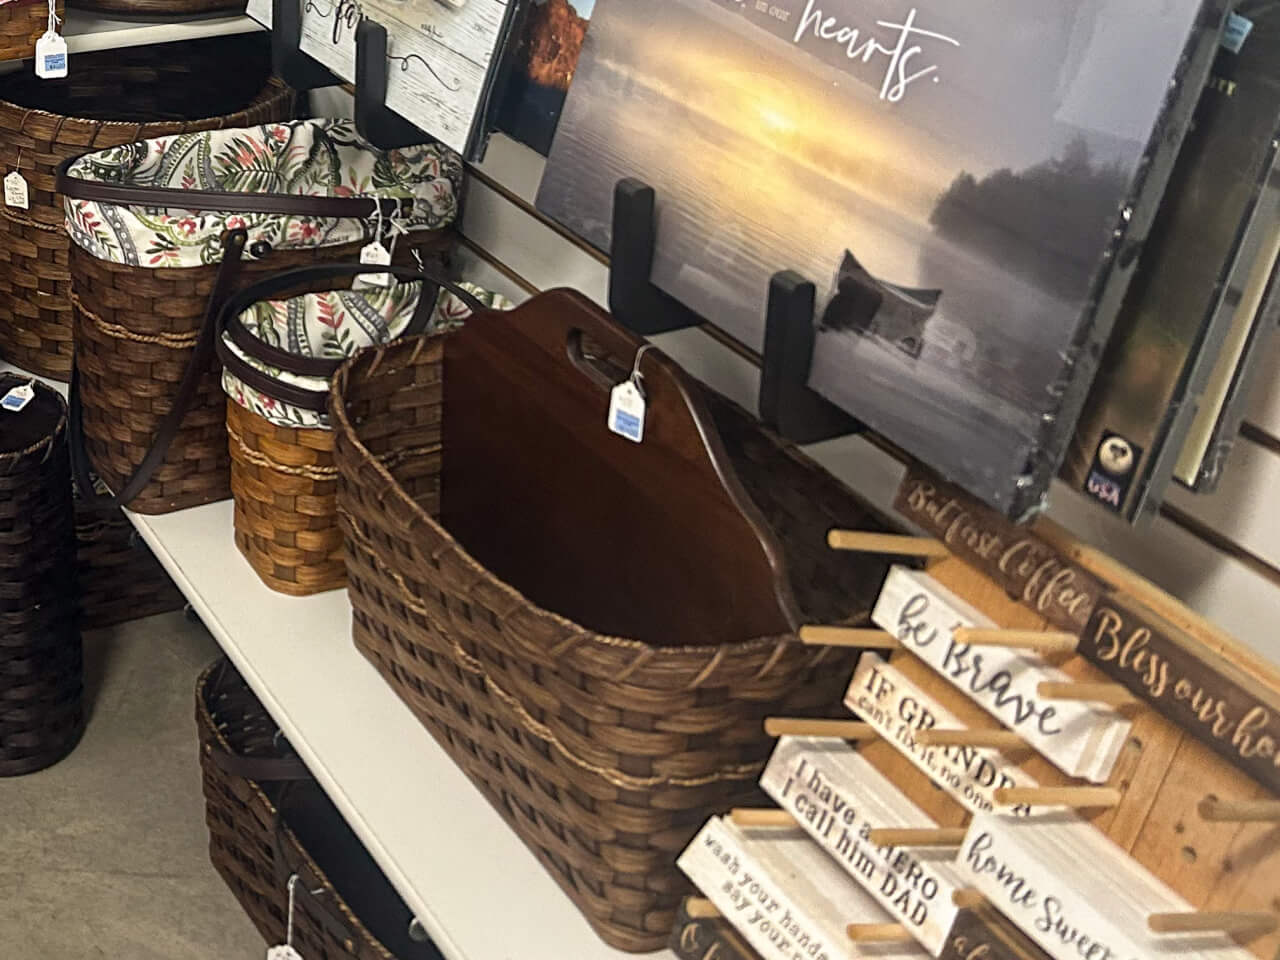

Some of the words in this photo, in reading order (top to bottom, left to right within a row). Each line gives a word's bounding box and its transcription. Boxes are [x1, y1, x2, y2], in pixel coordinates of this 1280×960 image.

[865, 667, 896, 701] IF
[897, 594, 937, 648] be
[942, 626, 1063, 737] Brave
[1091, 606, 1169, 699] Bless
[1172, 679, 1234, 739] our
[857, 695, 893, 731] can't
[940, 765, 961, 789] no
[794, 759, 808, 779] I
[807, 763, 857, 826] have
[704, 833, 738, 876] wash
[737, 871, 781, 913] your
[781, 777, 795, 798] I
[794, 792, 837, 839] call
[835, 829, 877, 880] him
[879, 870, 929, 928] DAD
[966, 831, 1038, 909] home
[721, 880, 746, 912] say
[747, 910, 792, 958] your
